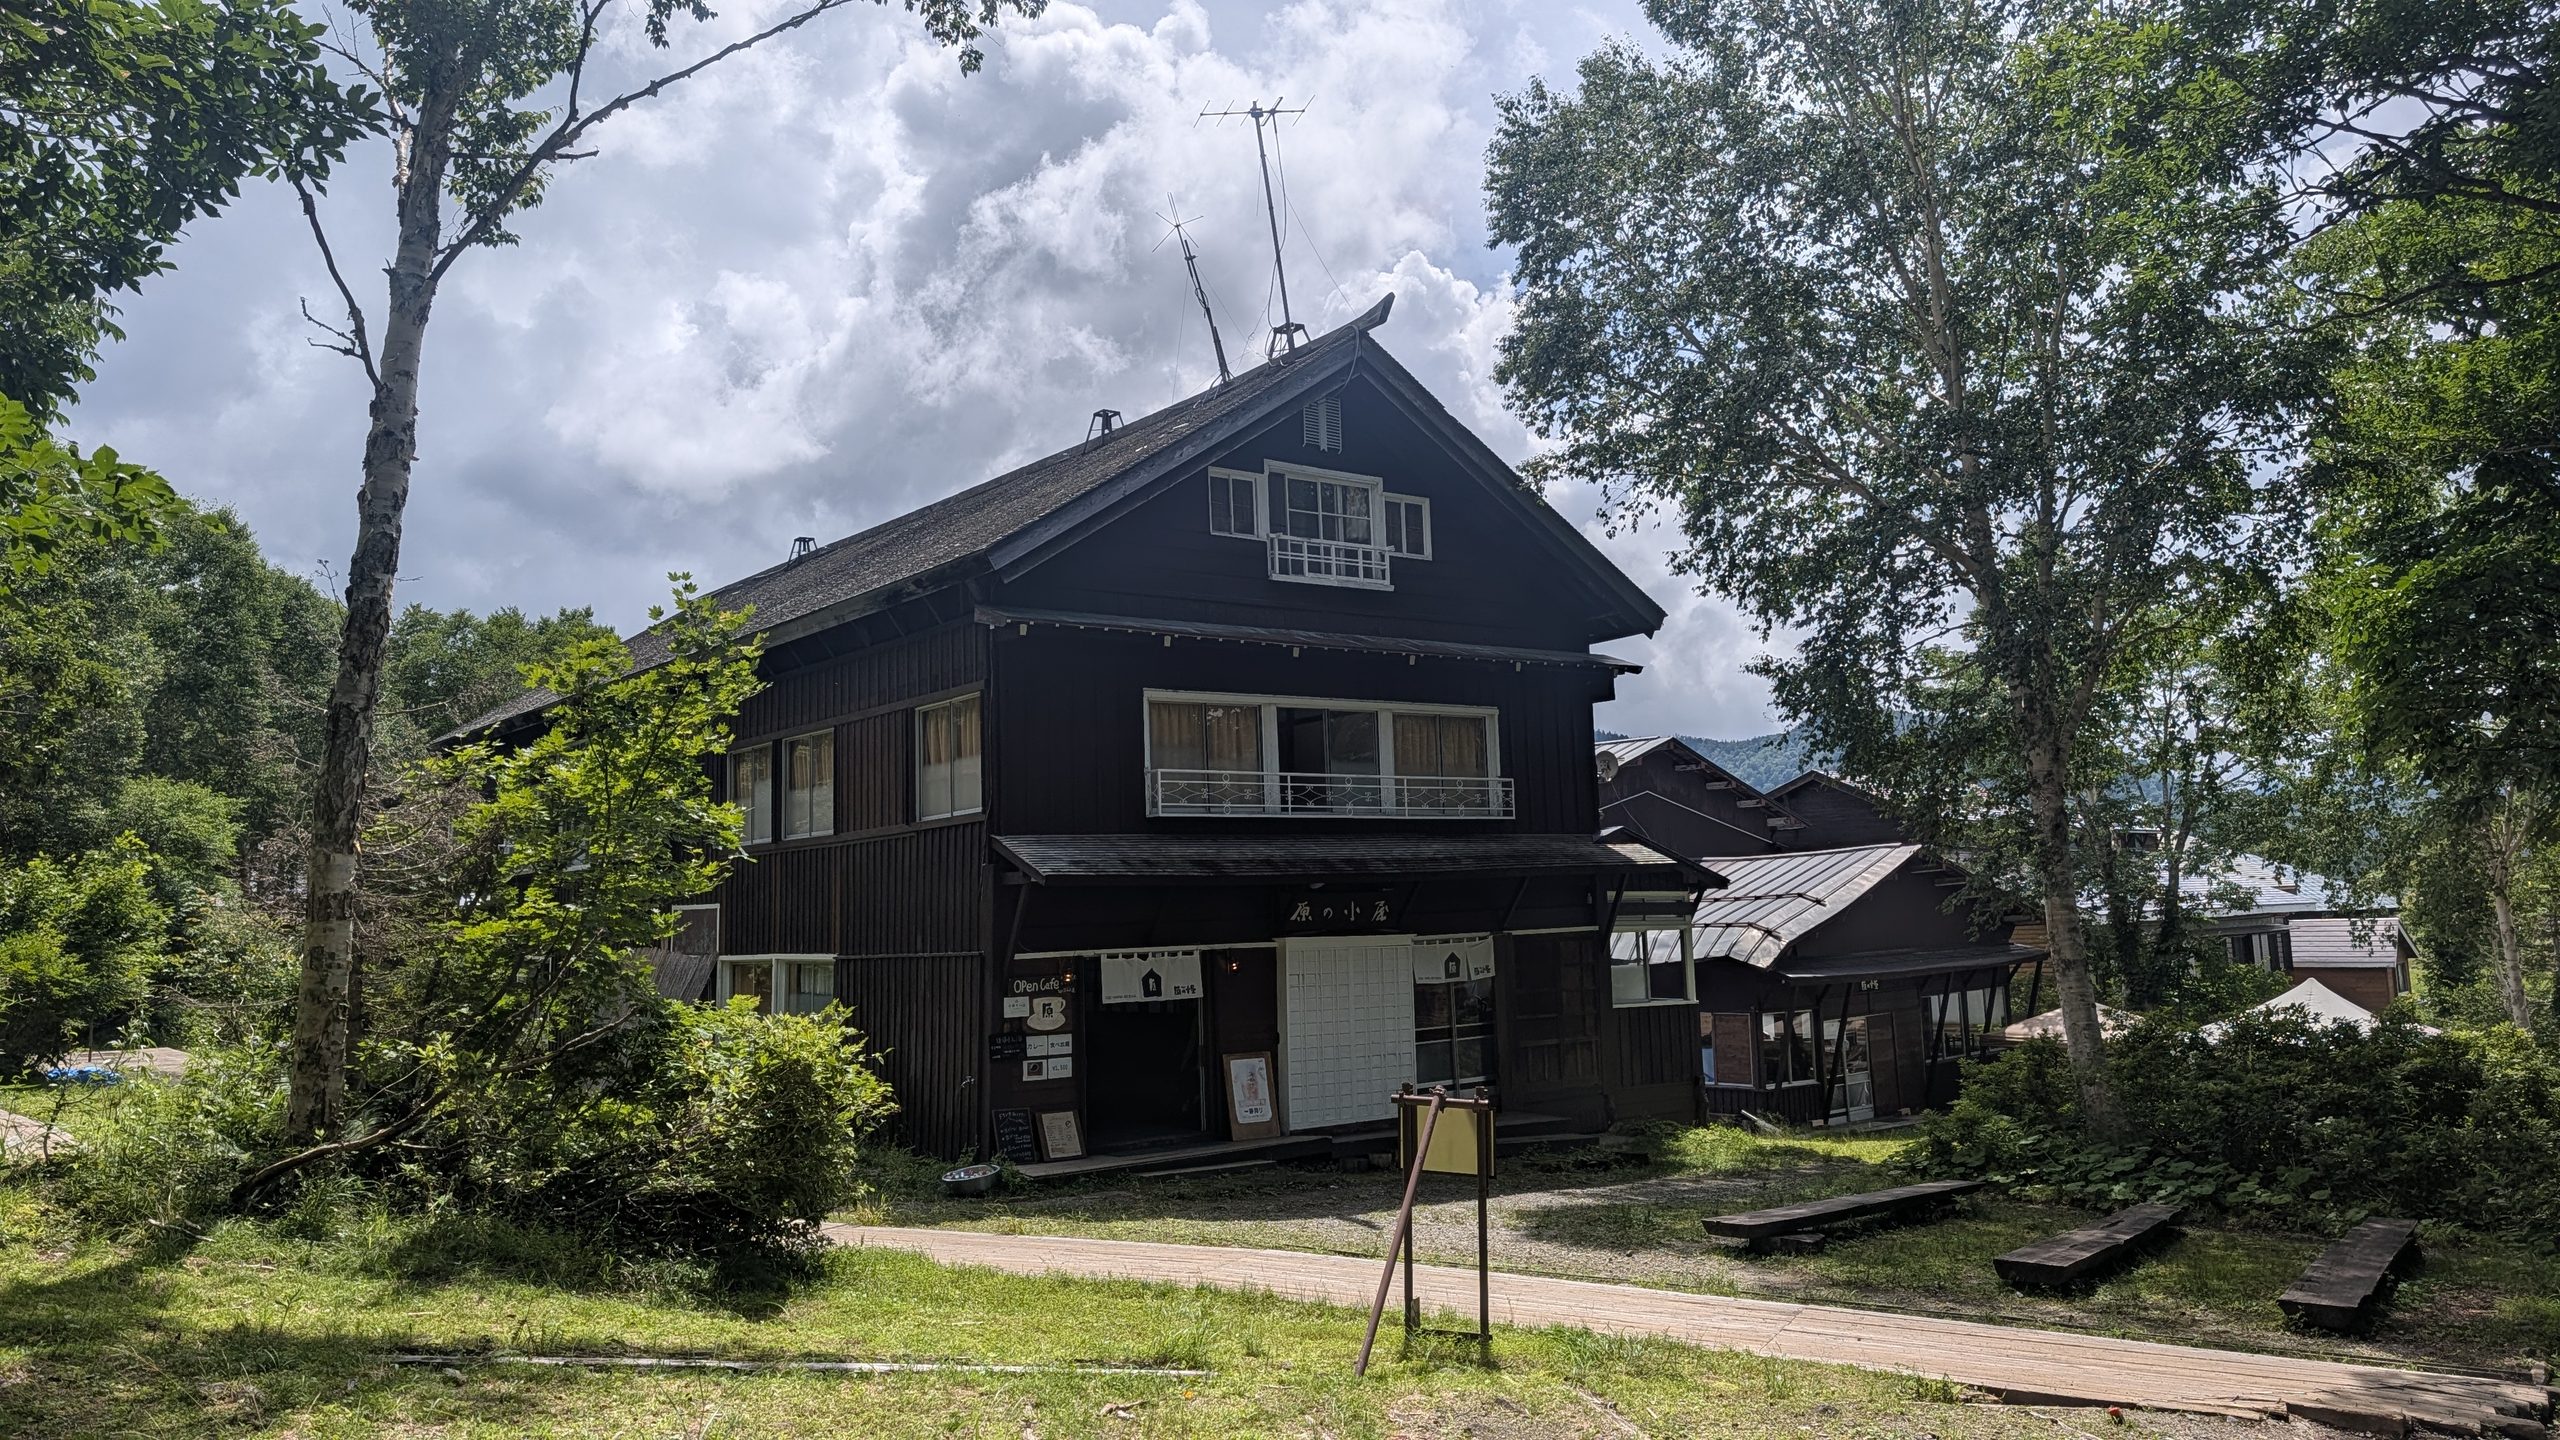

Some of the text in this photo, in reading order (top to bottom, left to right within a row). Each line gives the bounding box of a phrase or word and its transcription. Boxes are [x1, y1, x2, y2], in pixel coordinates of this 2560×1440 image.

[1289, 900, 1389, 922] 原の小屋
[1040, 977, 1060, 991] Cafe
[1042, 1002, 1053, 1018] 原
